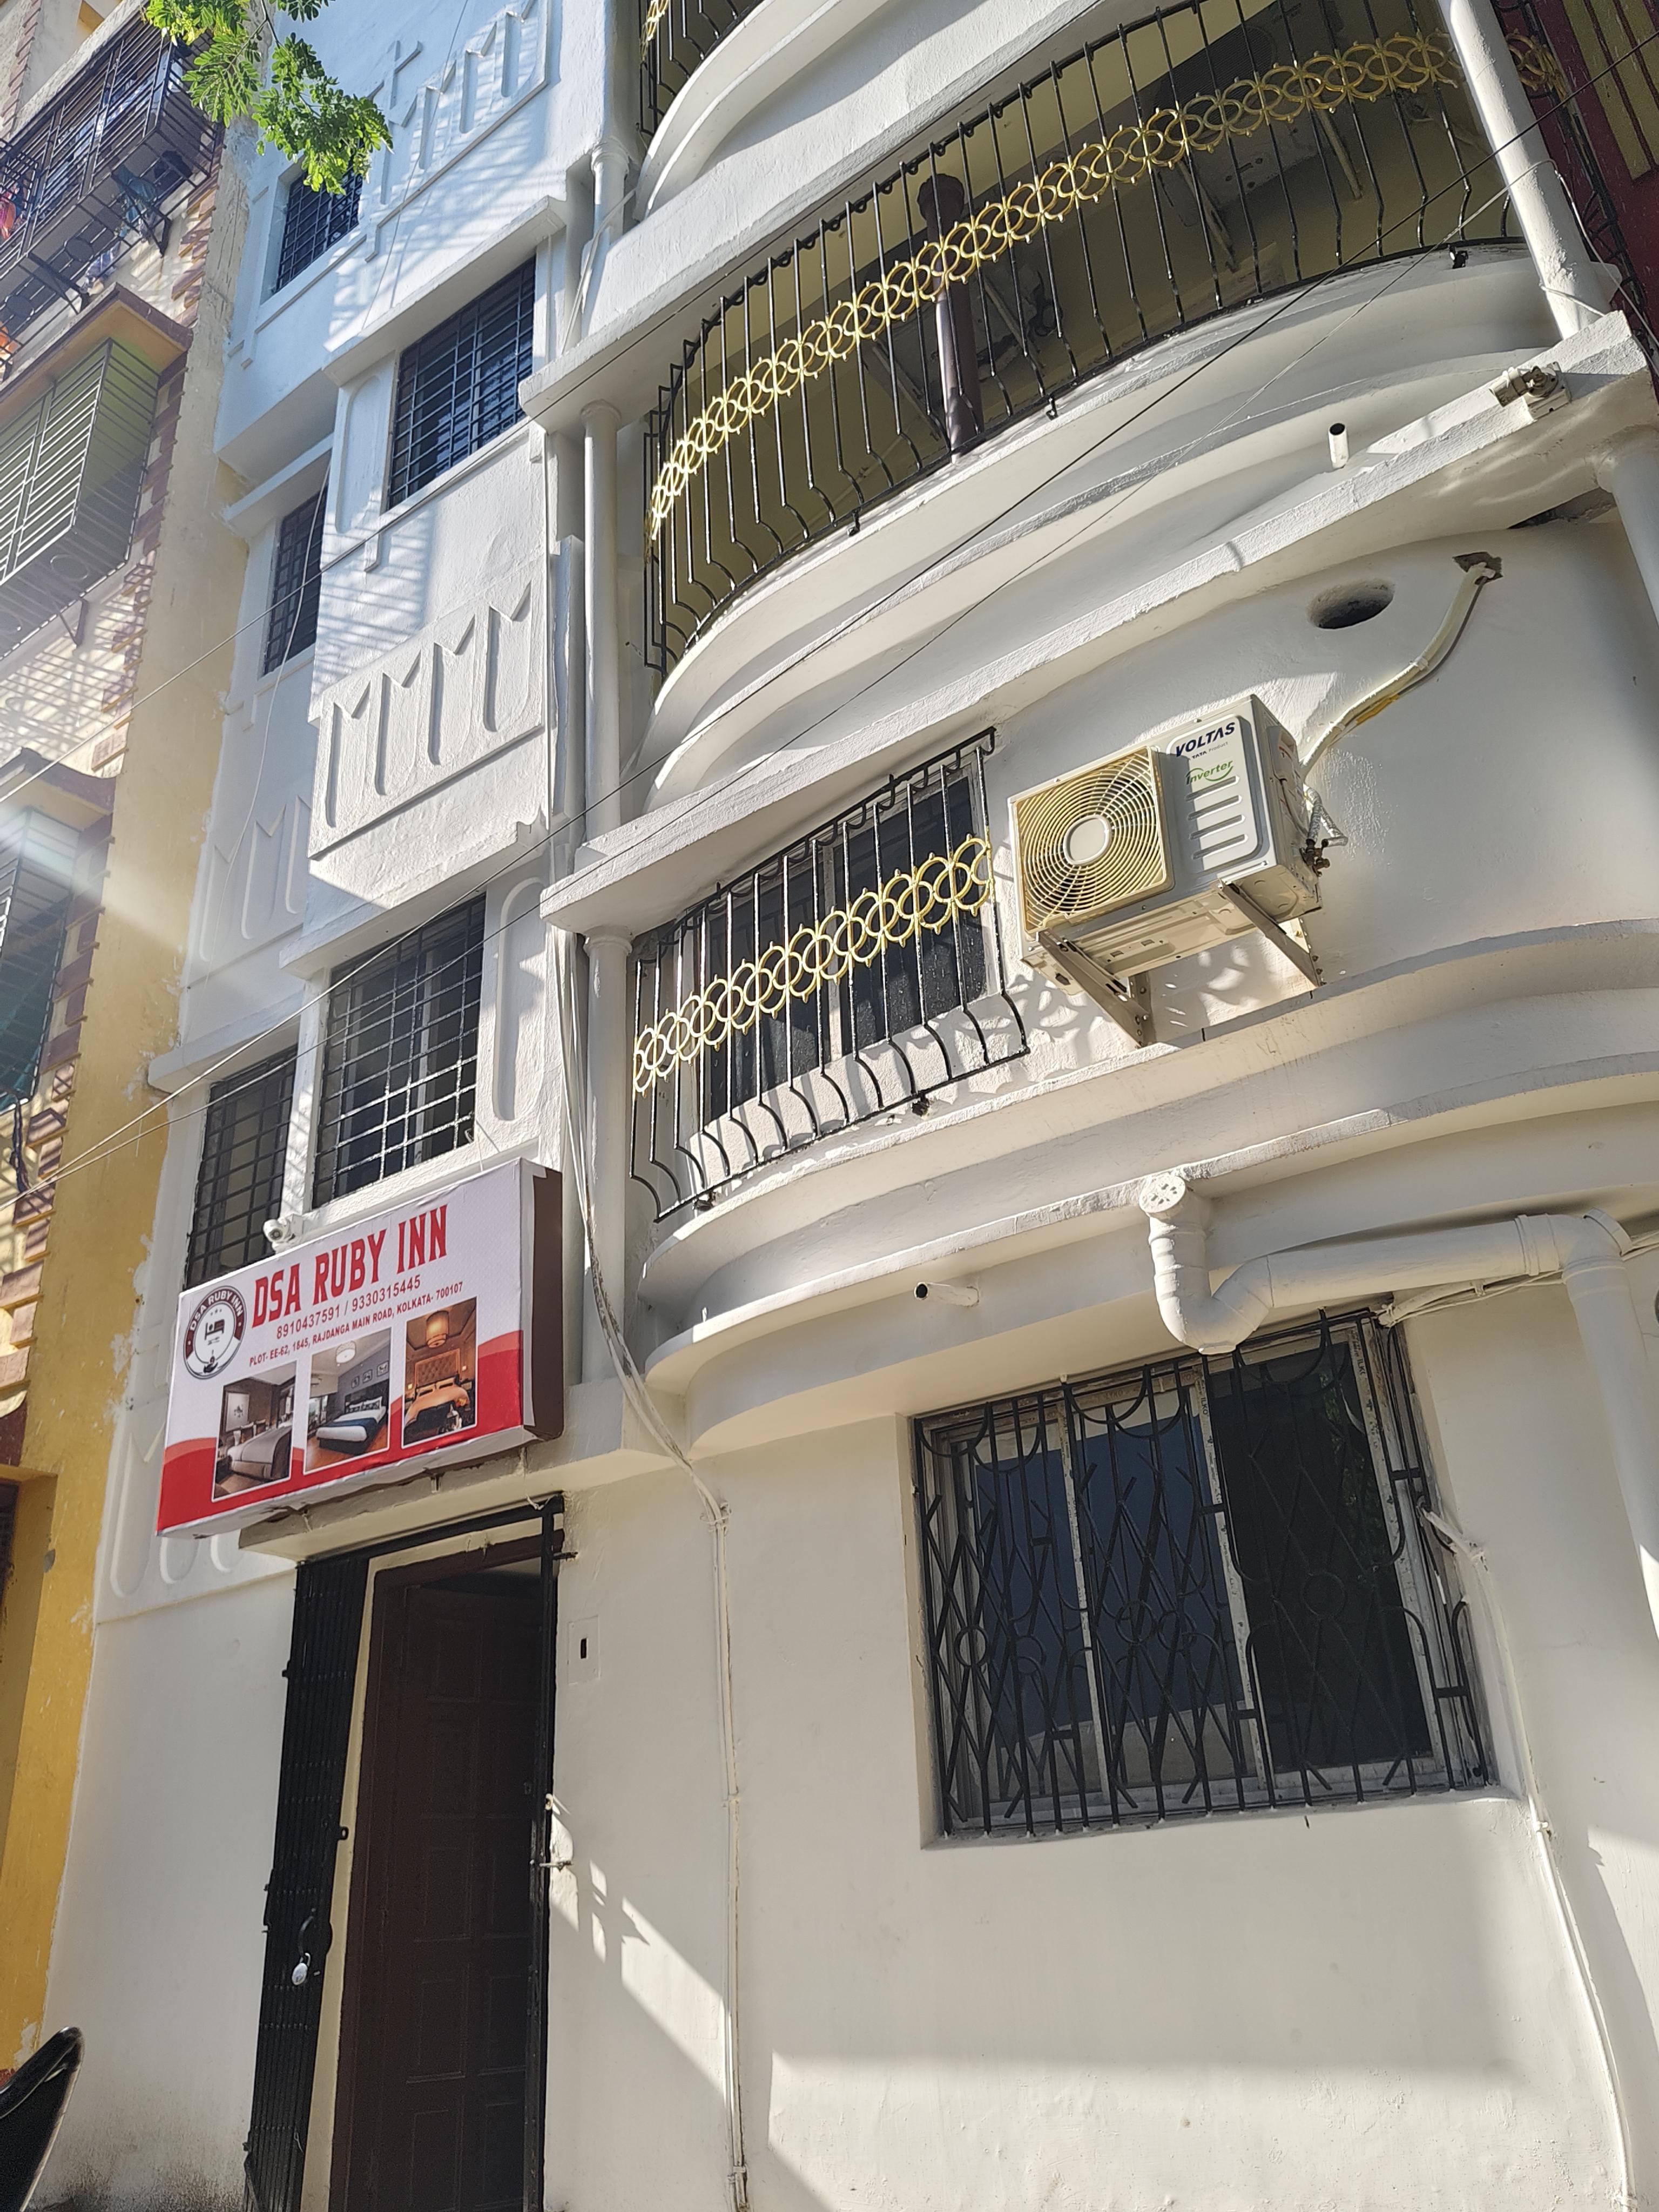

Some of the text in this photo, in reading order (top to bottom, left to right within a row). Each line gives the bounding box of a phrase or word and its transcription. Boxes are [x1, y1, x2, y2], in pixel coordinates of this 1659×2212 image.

[1176, 722, 1235, 757] VOLTAS
[1192, 741, 1229, 759] TATA Product
[252, 1204, 448, 1328] DSA RUBY INN
[190, 1290, 243, 1331] DSA RUBY INN
[276, 1304, 340, 1339] 8910437591
[352, 1274, 421, 1312] 9330315445
[313, 1325, 349, 1345] RAJDANGA
[352, 1314, 370, 1330] MAIN
[436, 1281, 463, 1300] 700107
